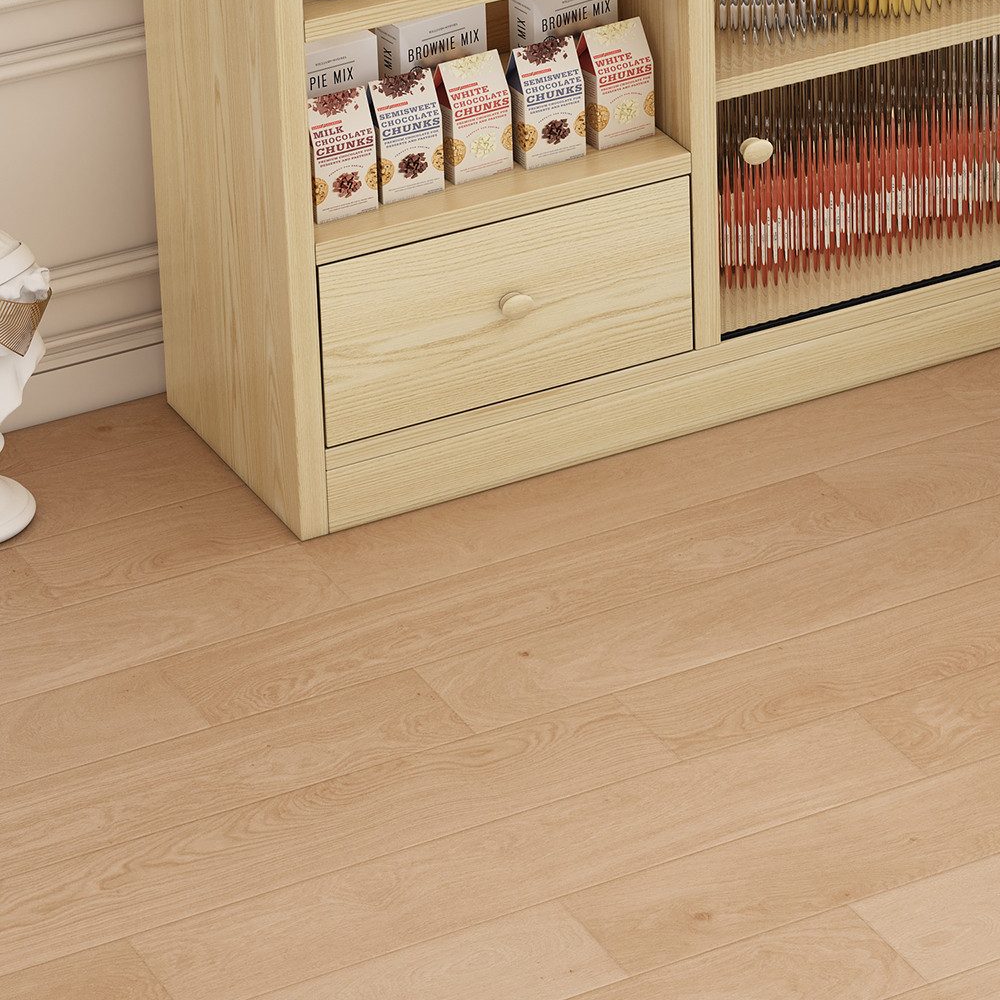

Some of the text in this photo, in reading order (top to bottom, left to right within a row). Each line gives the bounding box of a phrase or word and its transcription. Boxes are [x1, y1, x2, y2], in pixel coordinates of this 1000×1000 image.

[541, 0, 611, 32] BROWNIE MIX
[517, 17, 526, 40] MIX
[408, 36, 456, 63] BROWNIE
[460, 28, 480, 47] MIX
[383, 47, 393, 70] MIX
[595, 52, 633, 68] WHITE
[597, 56, 651, 75] CHOCOLATE
[309, 66, 354, 91] PIE MIX
[523, 68, 579, 87] SEMISWEET
[599, 64, 652, 84] CHUNKS
[451, 85, 489, 101] WHITE
[525, 76, 582, 94] CHOCOLATE
[527, 84, 582, 103] CHUNKS
[453, 89, 508, 109] CHOCOLATE
[455, 97, 509, 118] CHUNKS
[379, 101, 437, 120] SEMISWEET
[381, 109, 439, 128] CHOCOLATE
[313, 126, 344, 139] MILK
[315, 127, 373, 147] CHOCOLATE
[382, 117, 440, 137] CHUNKS
[316, 136, 374, 157] CHUNKS
